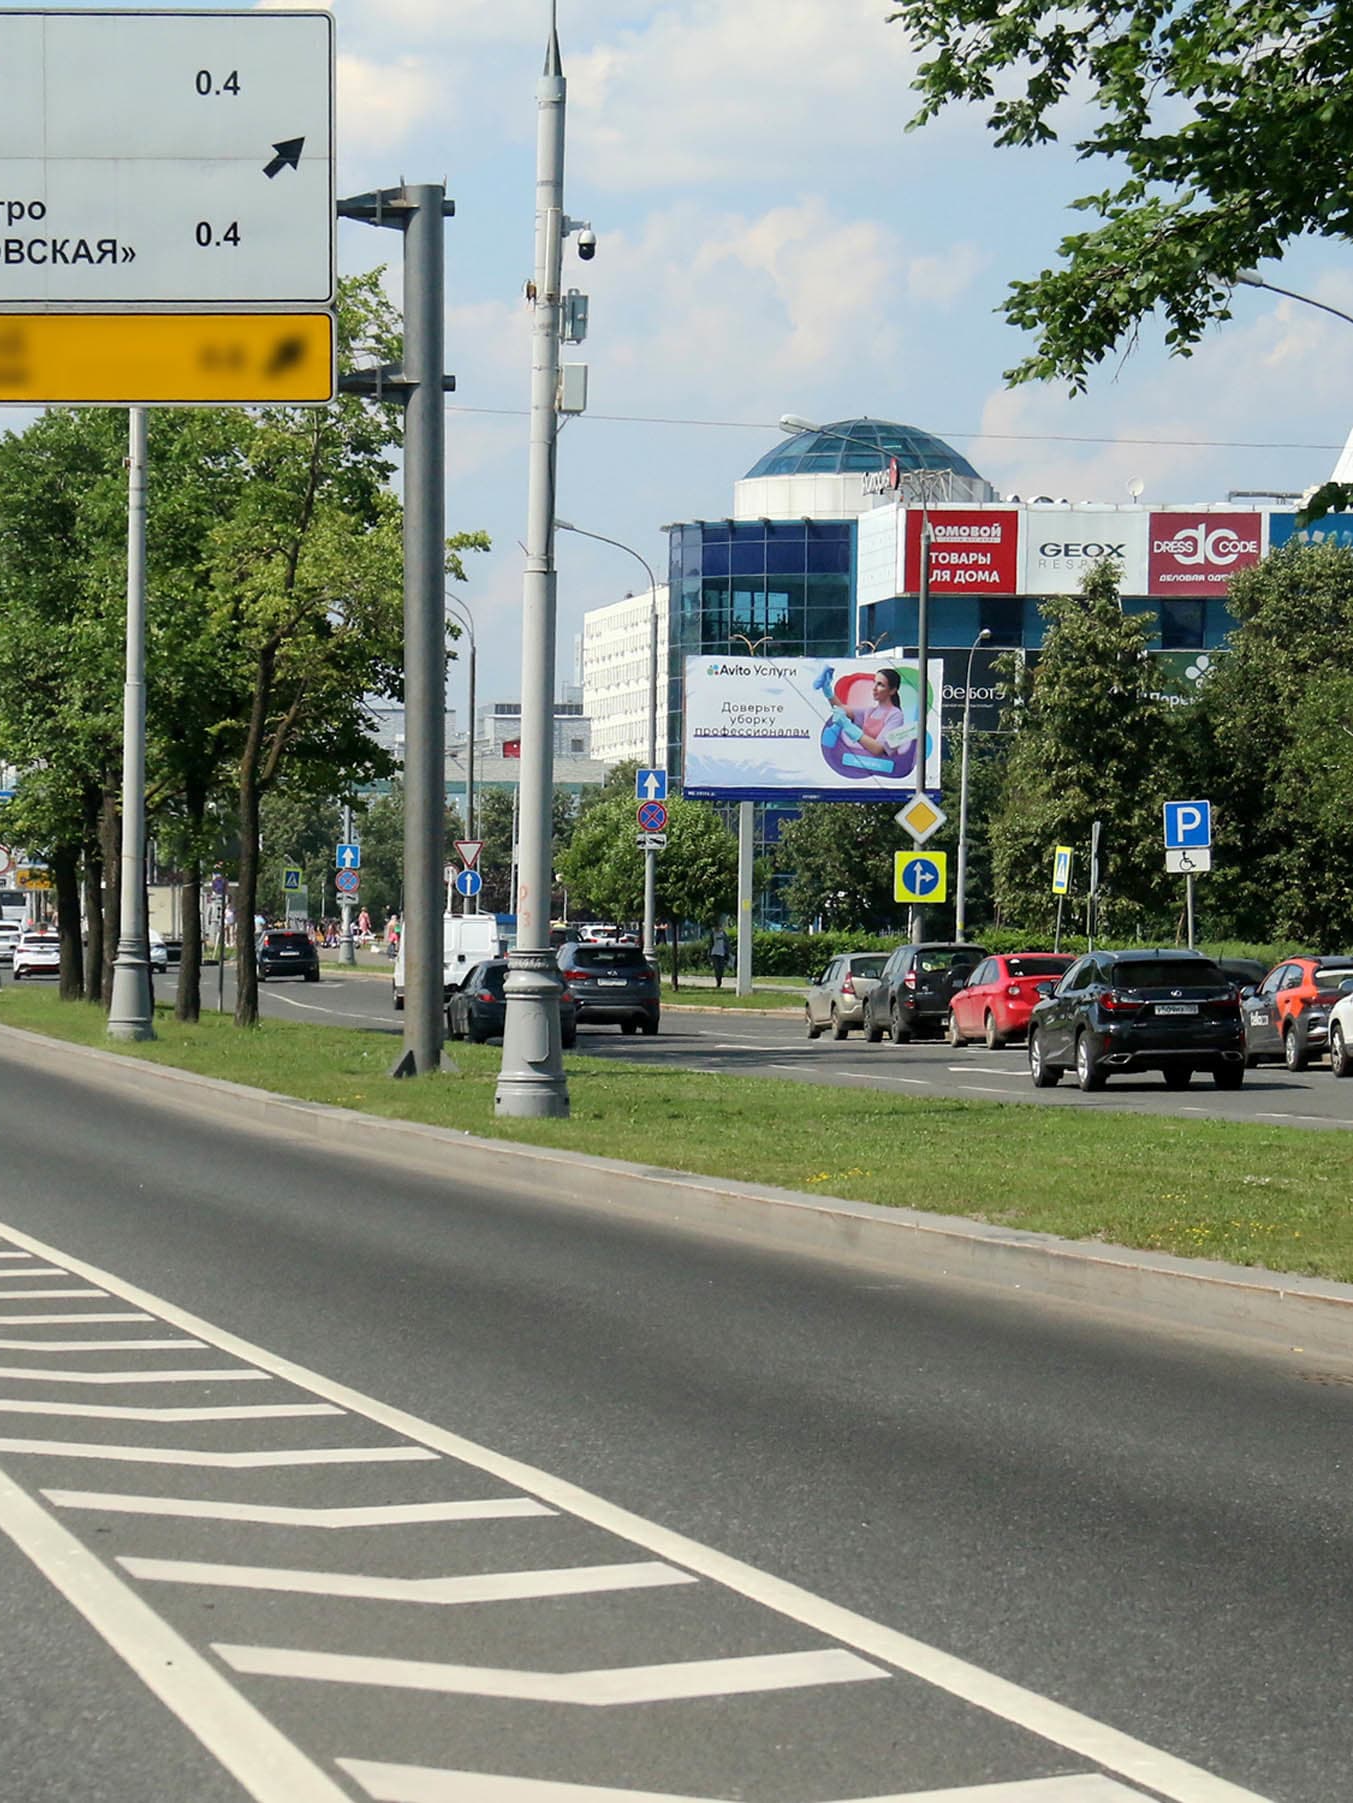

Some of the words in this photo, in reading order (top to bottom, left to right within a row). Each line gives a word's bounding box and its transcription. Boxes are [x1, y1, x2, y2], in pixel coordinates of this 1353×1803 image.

[195, 69, 241, 96] 0.4
[195, 221, 241, 247] 0.4
[1039, 542, 1127, 558] GEOX
[1153, 540, 1194, 553] DRESS
[1218, 540, 1259, 553] CODE
[929, 552, 991, 565] ТОВАРЫ
[929, 570, 951, 584] ЛЯ
[953, 570, 1000, 584] ДОМА
[720, 664, 751, 676] Avito
[753, 664, 797, 679] Услуги
[721, 701, 784, 714] Доверьте
[729, 714, 776, 726] уборку
[694, 726, 809, 737] профессионалам
